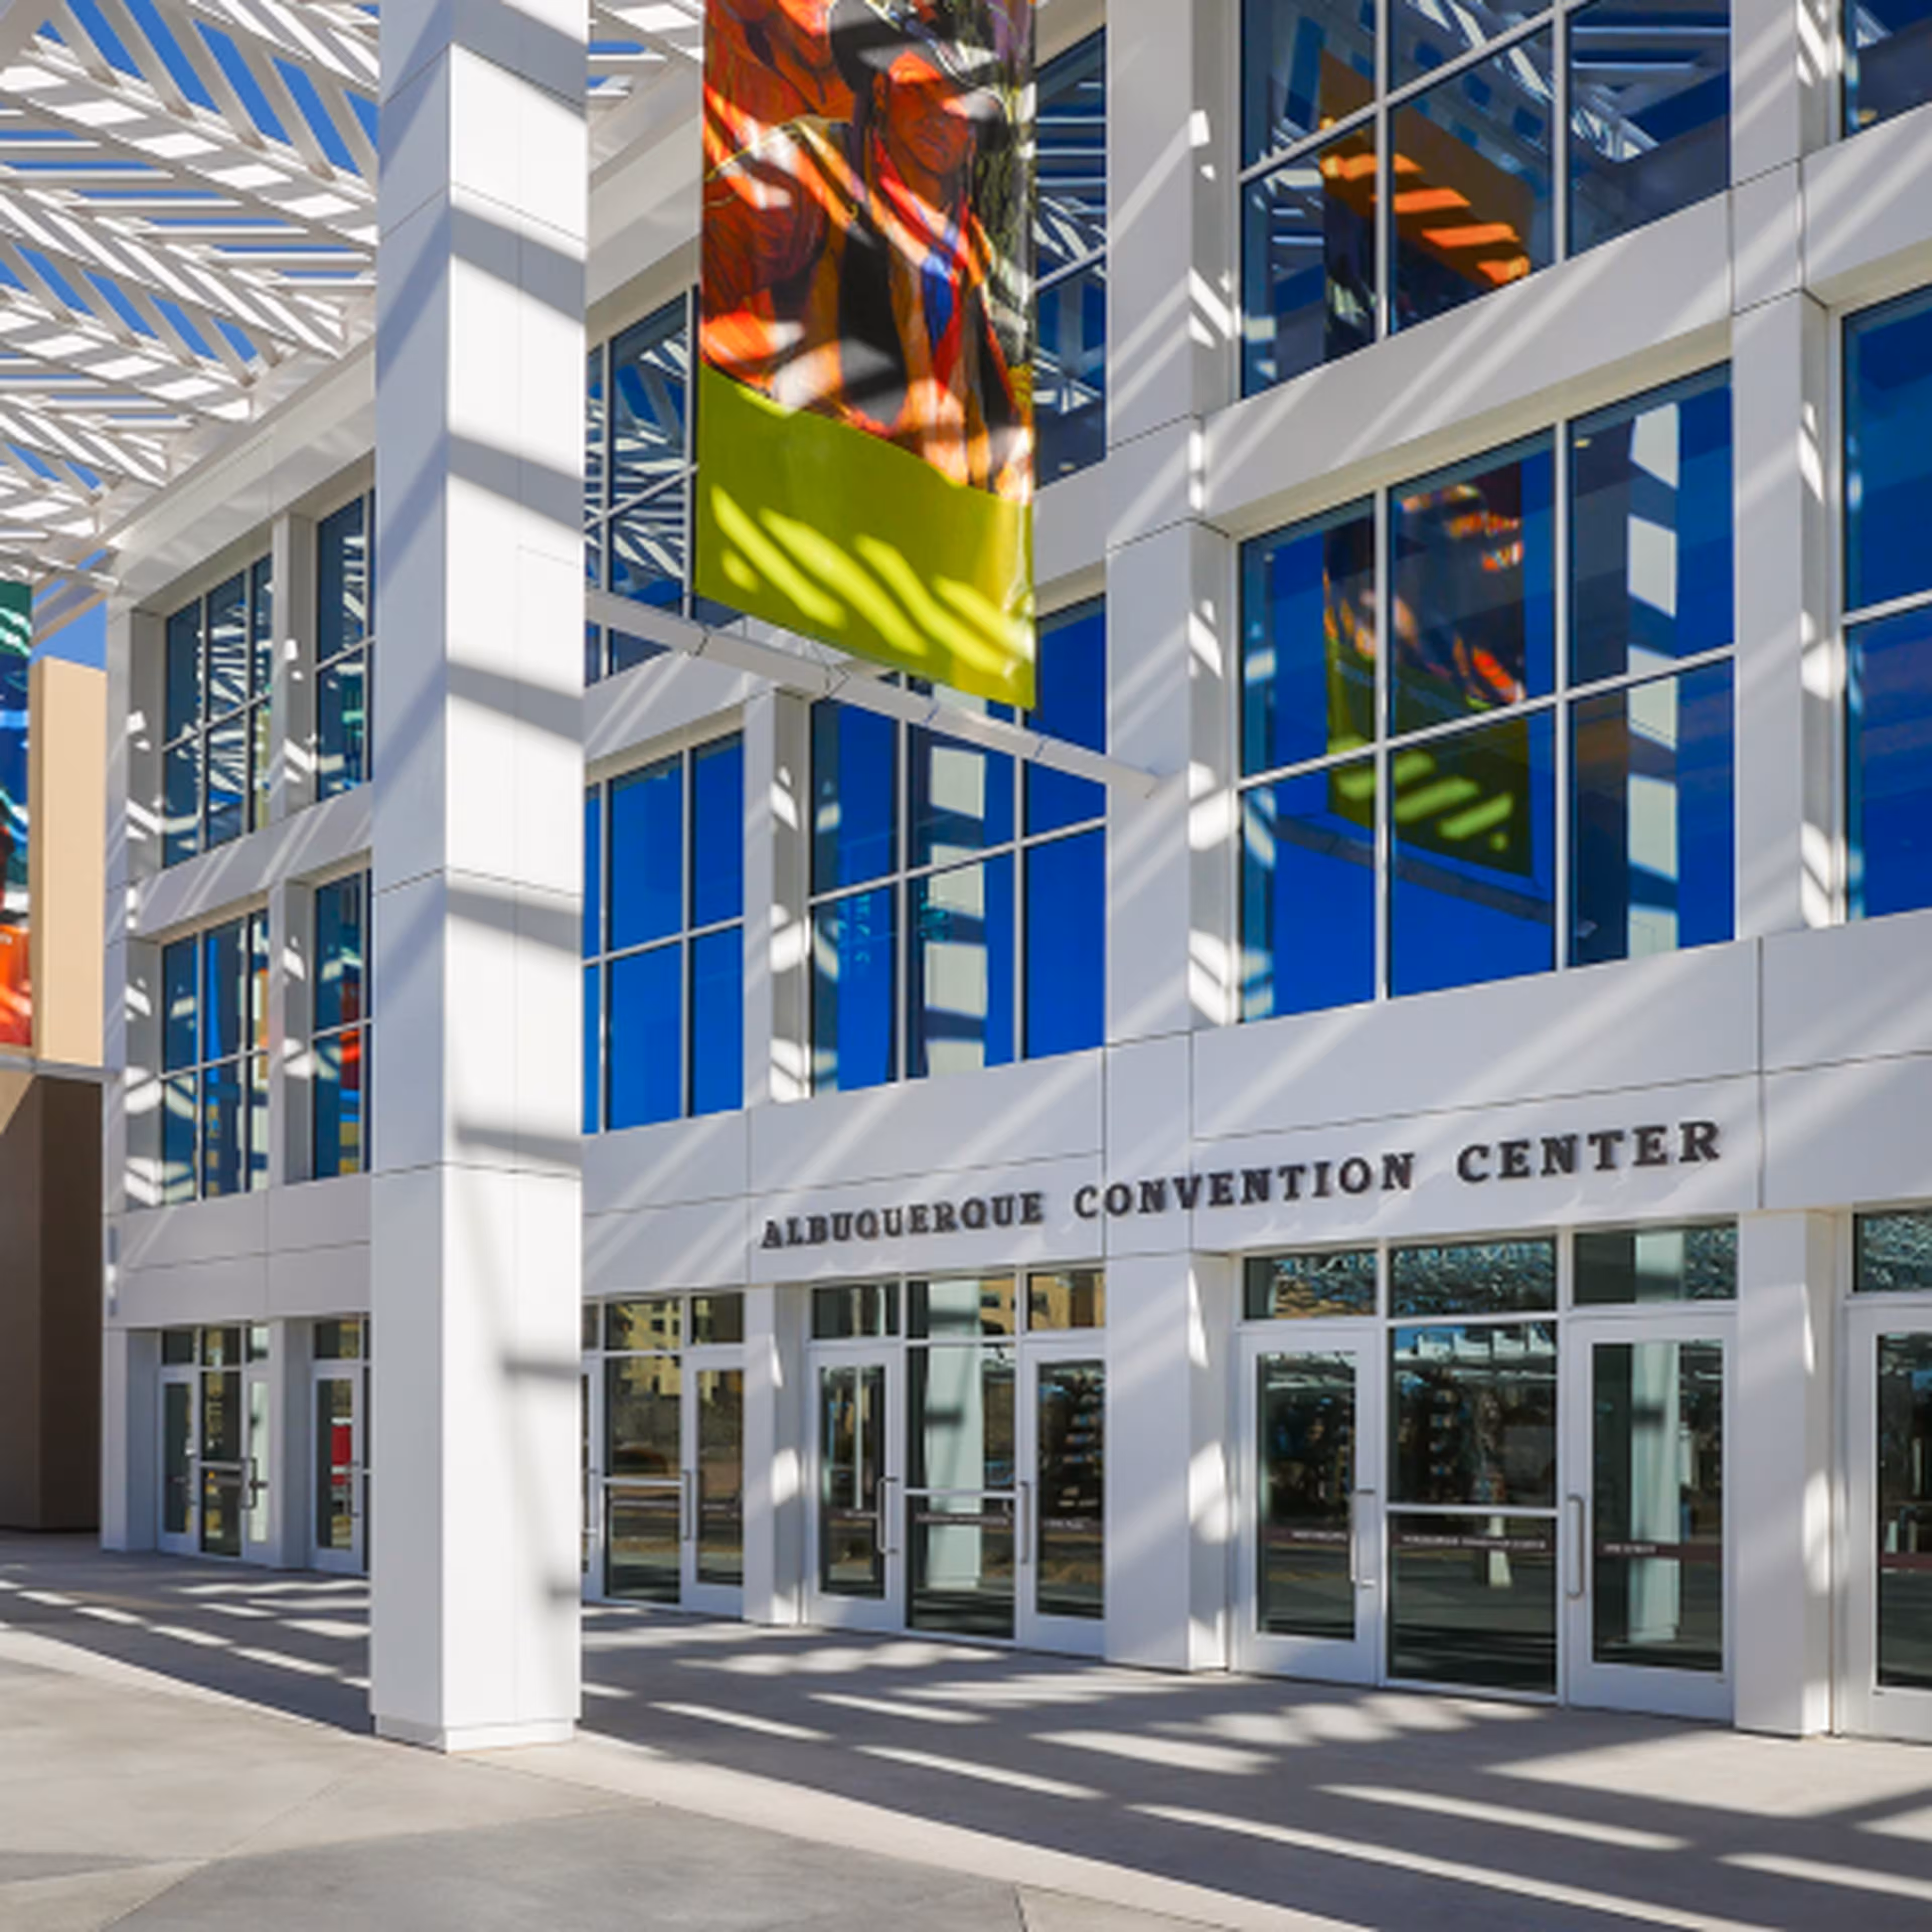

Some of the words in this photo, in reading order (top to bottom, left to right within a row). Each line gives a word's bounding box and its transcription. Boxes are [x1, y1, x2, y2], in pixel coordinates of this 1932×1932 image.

[761, 1191, 1044, 1249] ALBUQUERQUE
[1074, 1151, 1415, 1219] CONVENTION
[1457, 1120, 1721, 1183] CENTER
